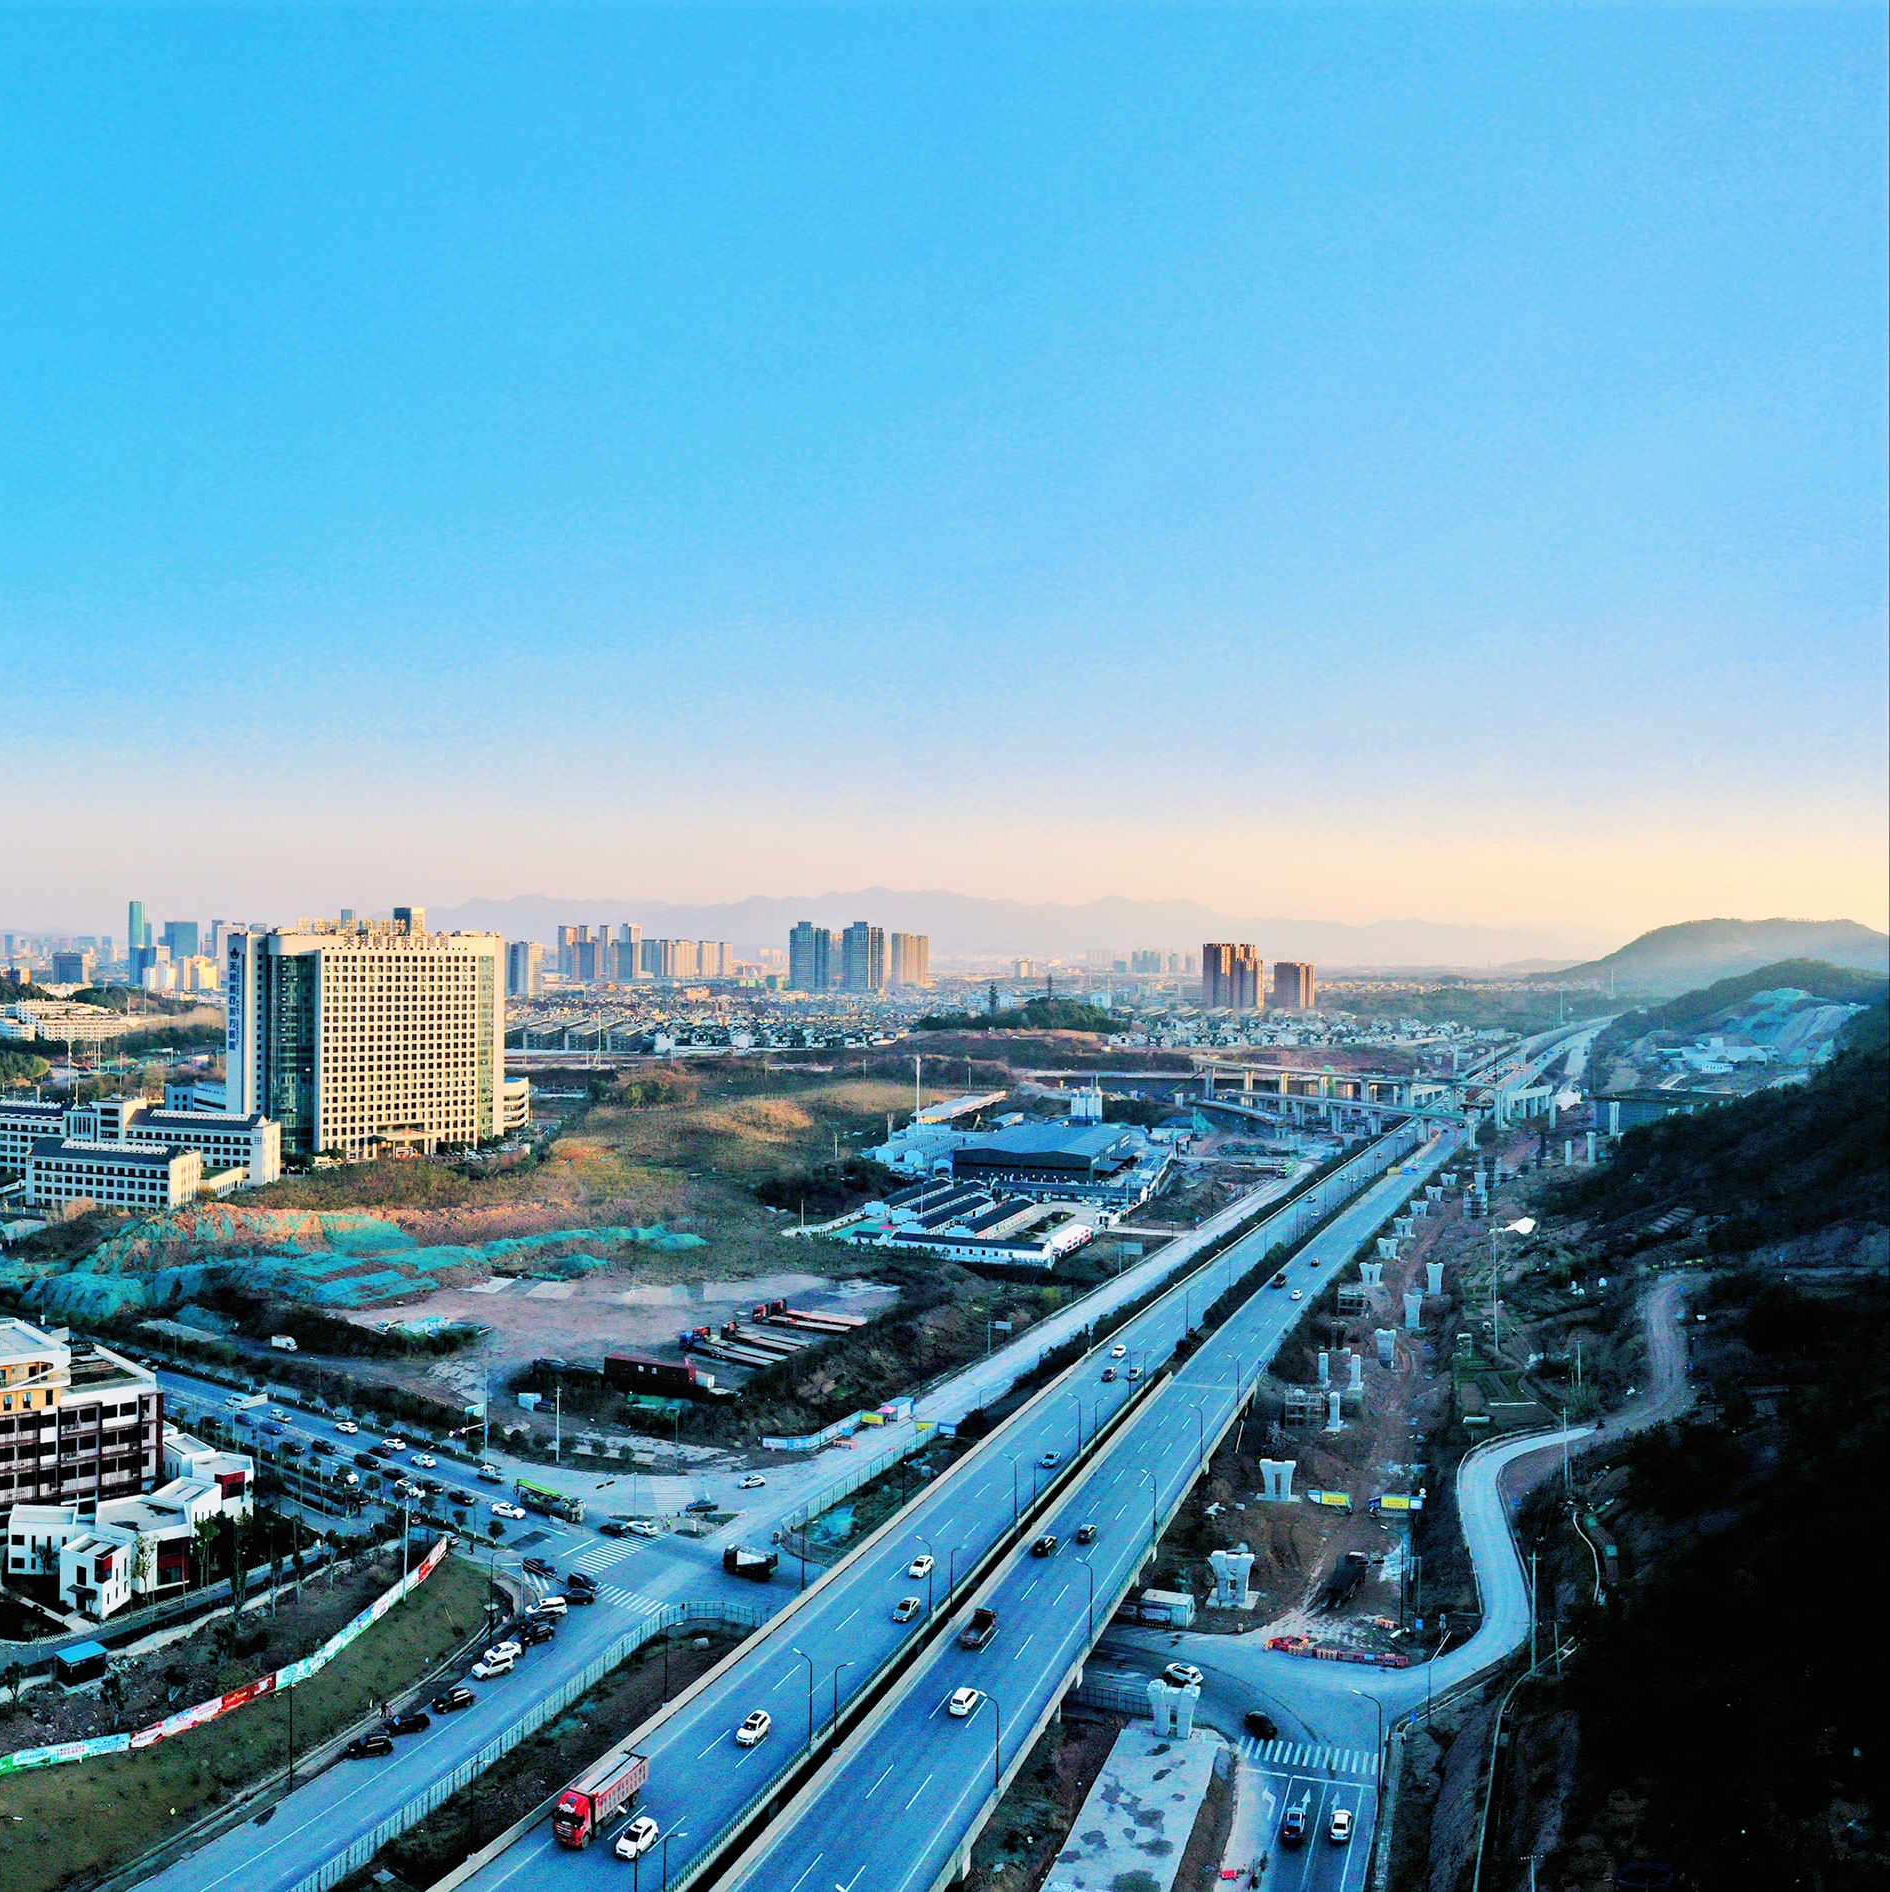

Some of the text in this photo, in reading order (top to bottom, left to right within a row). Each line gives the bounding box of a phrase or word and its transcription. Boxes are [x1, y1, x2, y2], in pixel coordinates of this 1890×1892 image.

[343, 935, 449, 948] 天祥医疗东方医院
[229, 961, 237, 1051] 天祥医疗东方医院
